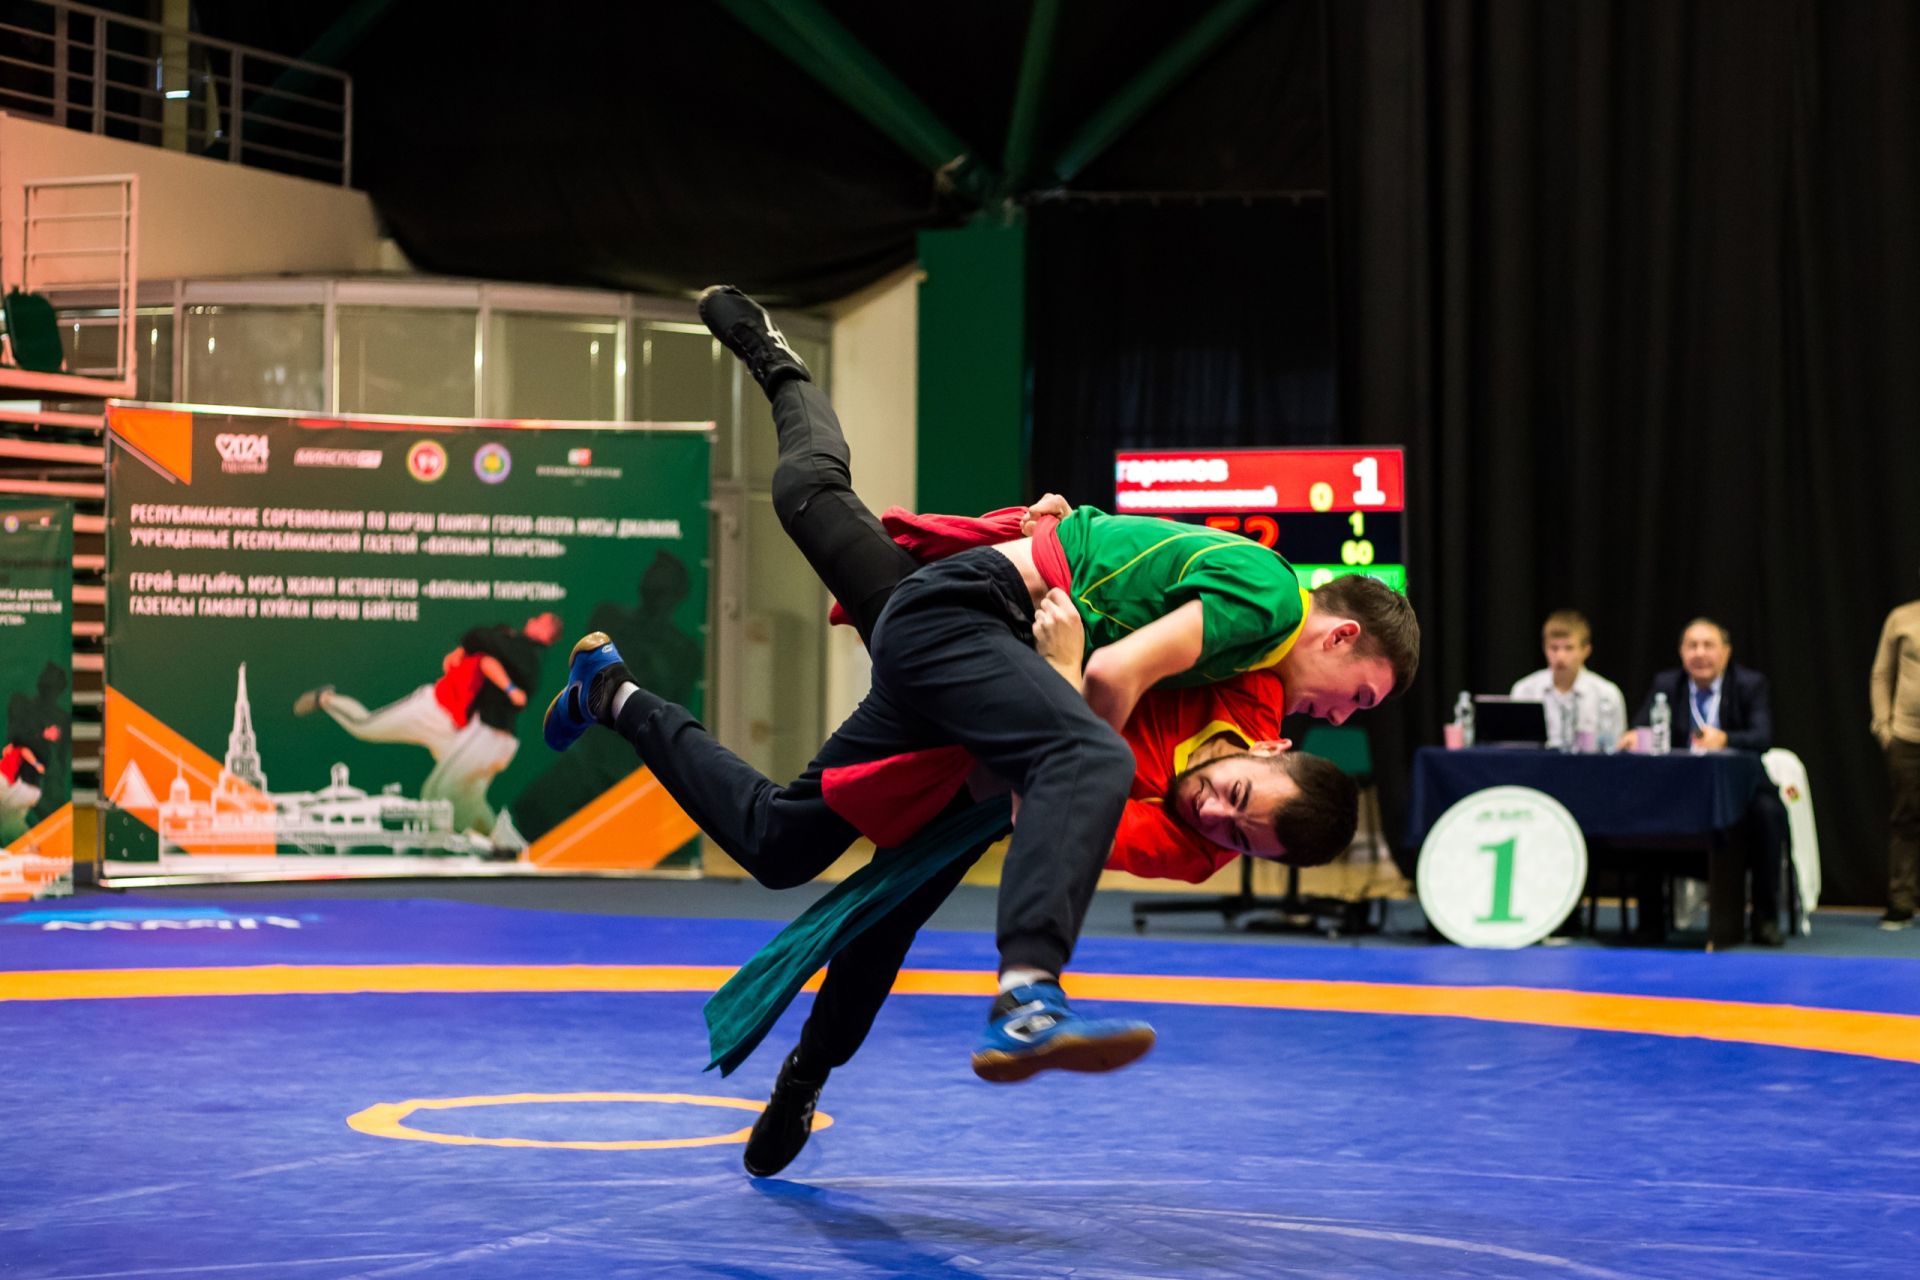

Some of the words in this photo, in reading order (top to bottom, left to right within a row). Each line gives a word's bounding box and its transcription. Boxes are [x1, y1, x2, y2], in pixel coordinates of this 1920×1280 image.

[1352, 457, 1386, 505] 1
[1309, 482, 1334, 512] 0
[130, 504, 260, 527] РЕСПУБЛИКАНСКИЕ
[262, 508, 364, 530] СОРЕВНОВАНИЯ
[367, 510, 386, 531] ПО
[1349, 511, 1364, 536] 1
[130, 527, 230, 549] УЧРЕЖДЕННЫЕ
[1475, 835, 1525, 924] 1
